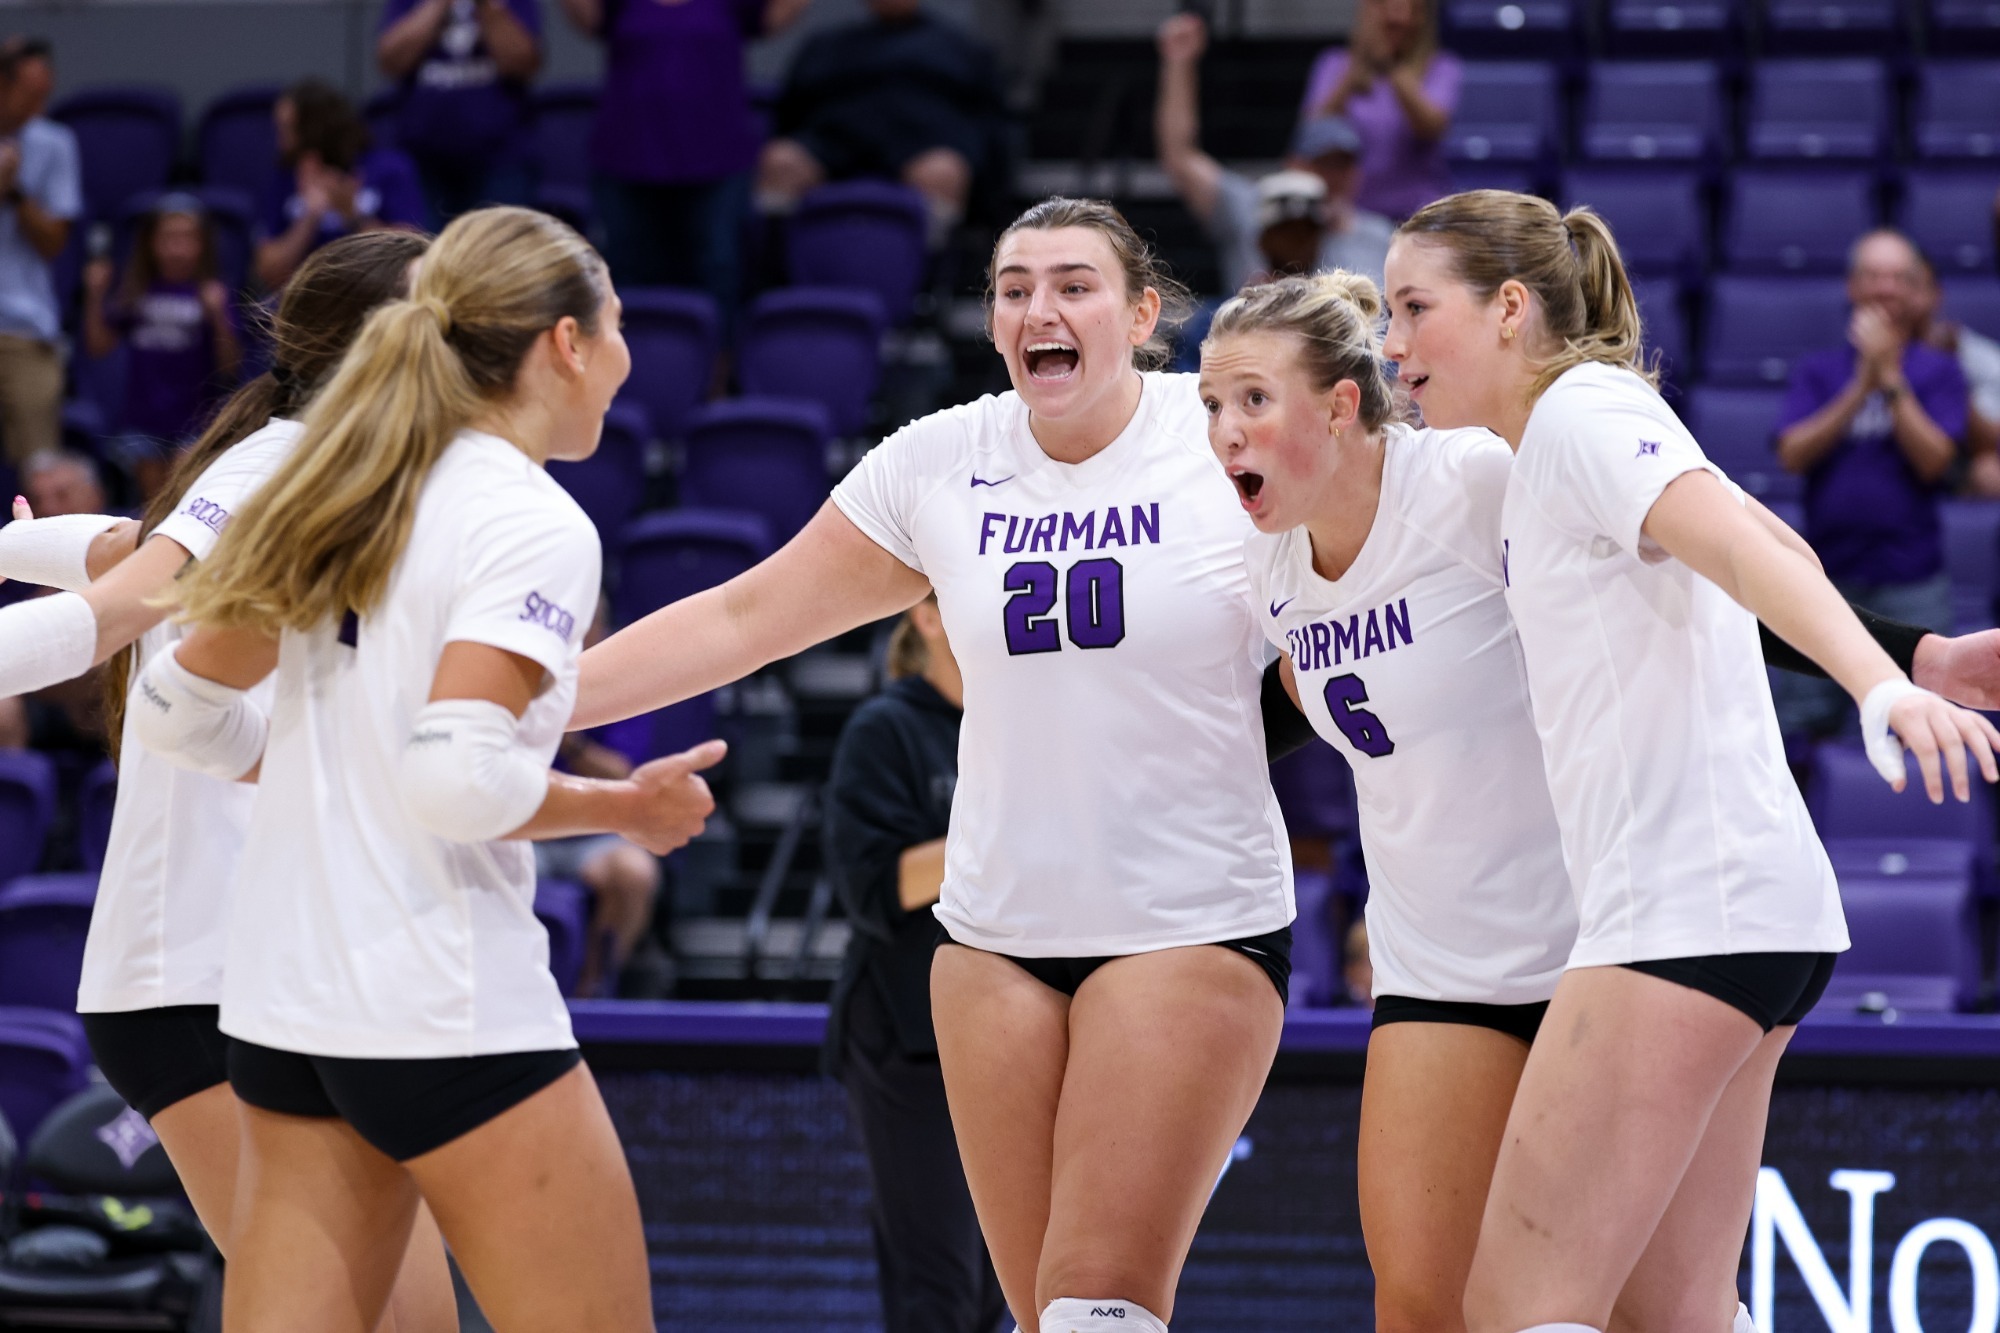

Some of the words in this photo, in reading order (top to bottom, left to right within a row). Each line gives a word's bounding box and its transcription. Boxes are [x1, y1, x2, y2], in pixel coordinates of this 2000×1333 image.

[182, 497, 231, 536] SOCO
[979, 502, 1160, 555] FURMAN
[1003, 556, 1126, 656] 20
[1323, 672, 1395, 758] 6
[1751, 1166, 2000, 1333] No
